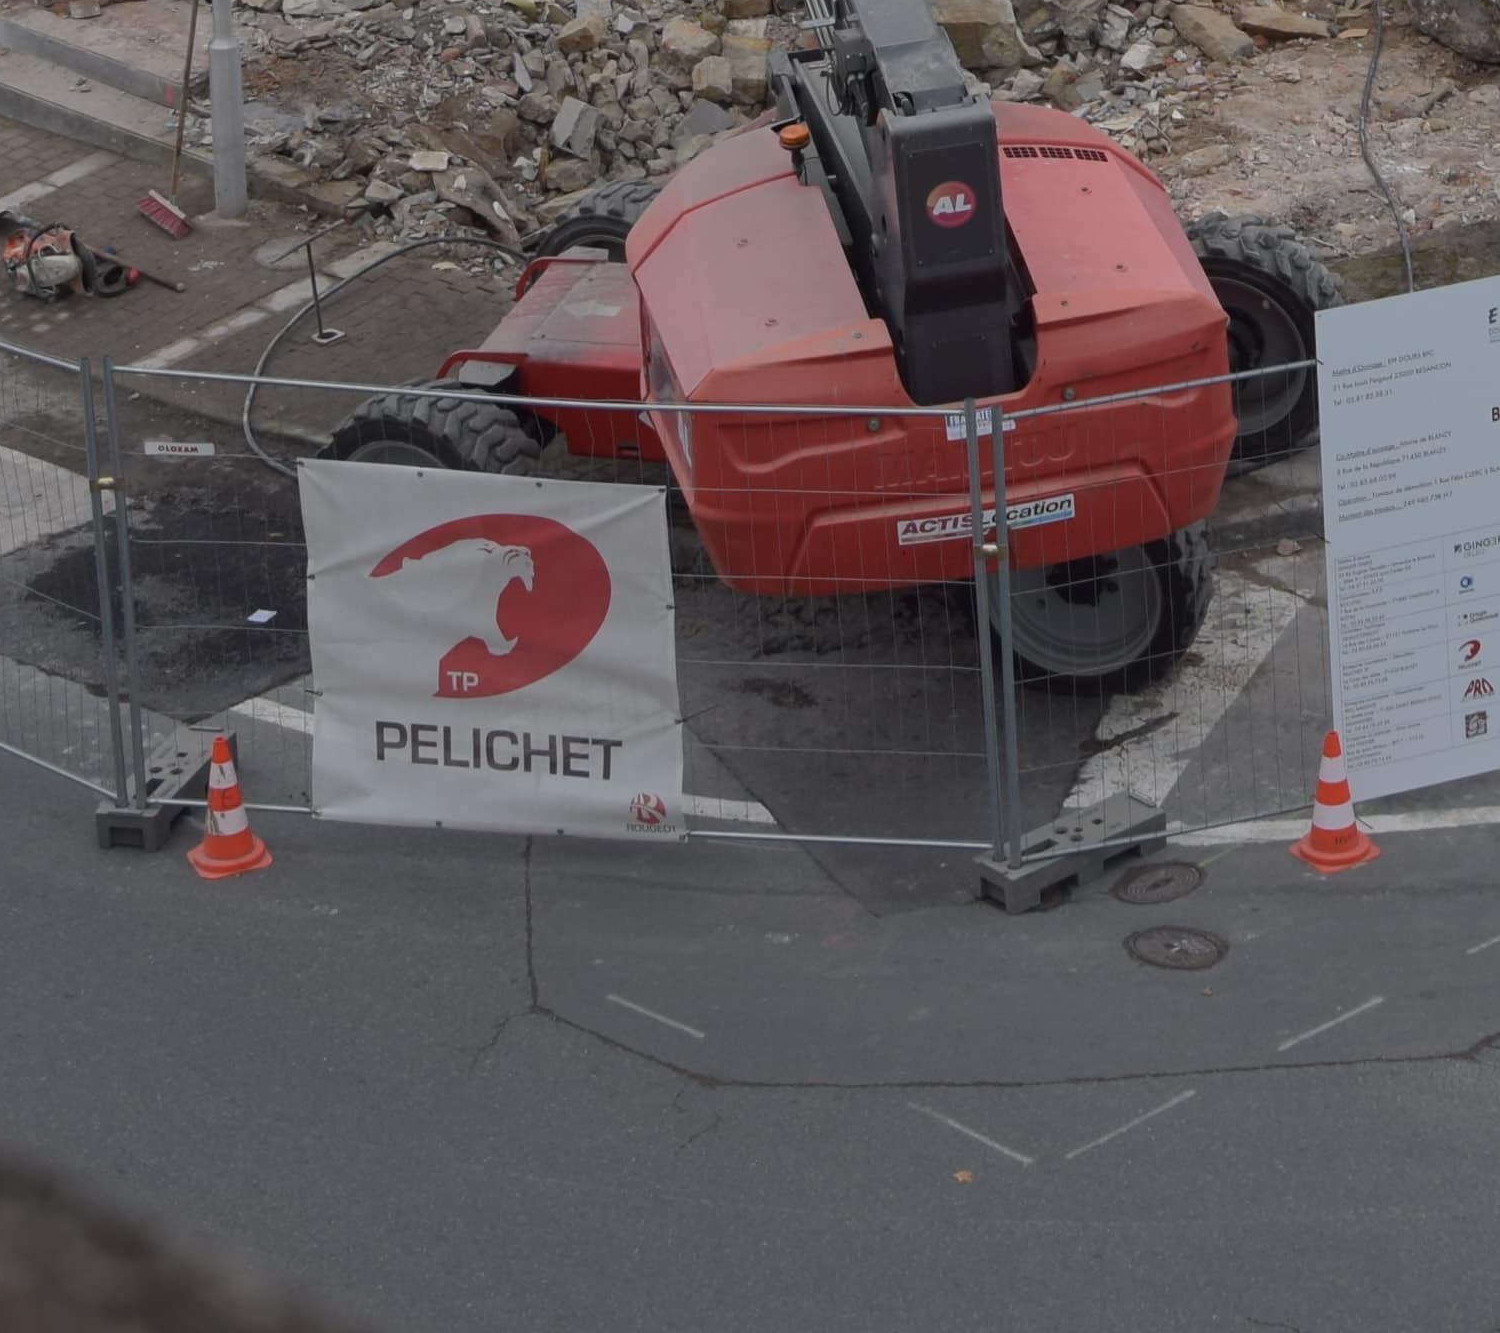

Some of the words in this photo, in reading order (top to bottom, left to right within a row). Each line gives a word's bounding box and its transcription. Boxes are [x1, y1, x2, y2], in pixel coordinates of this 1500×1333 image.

[932, 193, 972, 216] AL
[447, 671, 479, 692] TP
[375, 720, 623, 781] PELICHET
